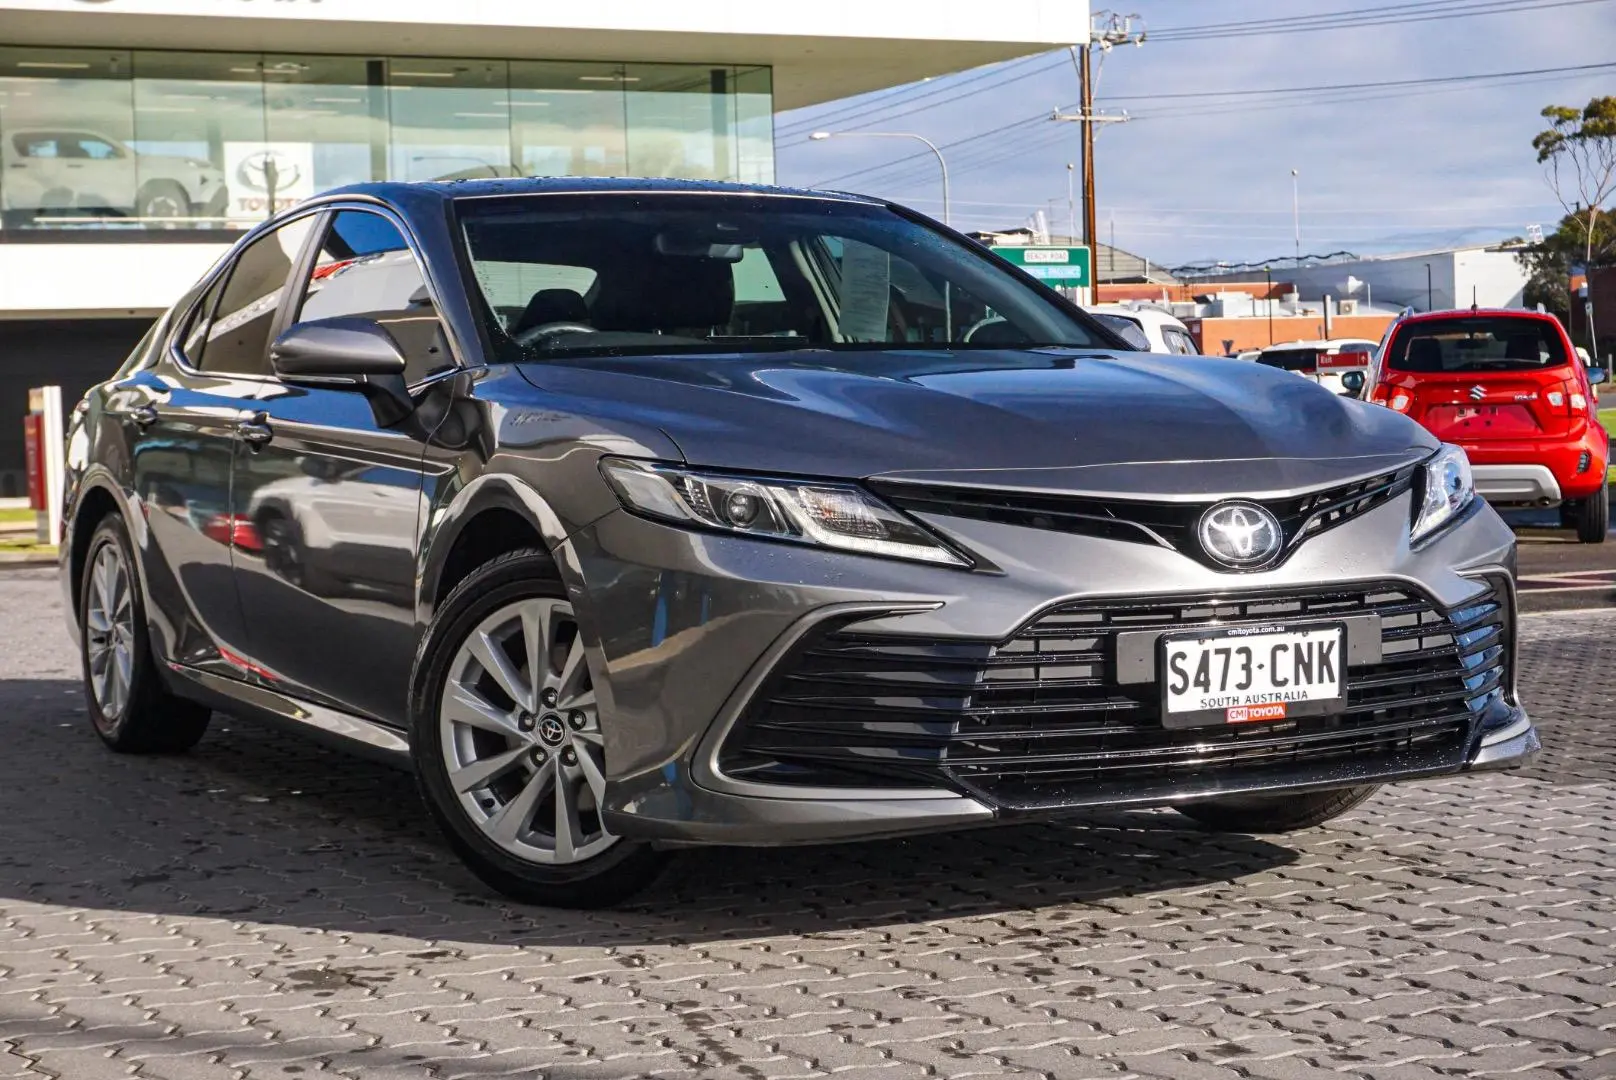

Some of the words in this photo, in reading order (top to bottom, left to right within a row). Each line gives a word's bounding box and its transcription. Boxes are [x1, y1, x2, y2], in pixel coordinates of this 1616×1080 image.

[1227, 625, 1285, 636] cmitoyota.com.au
[1200, 696, 1240, 709] SOUTH
[1245, 690, 1309, 705] AUSTRALIA
[1249, 705, 1285, 718] TOYOTA
